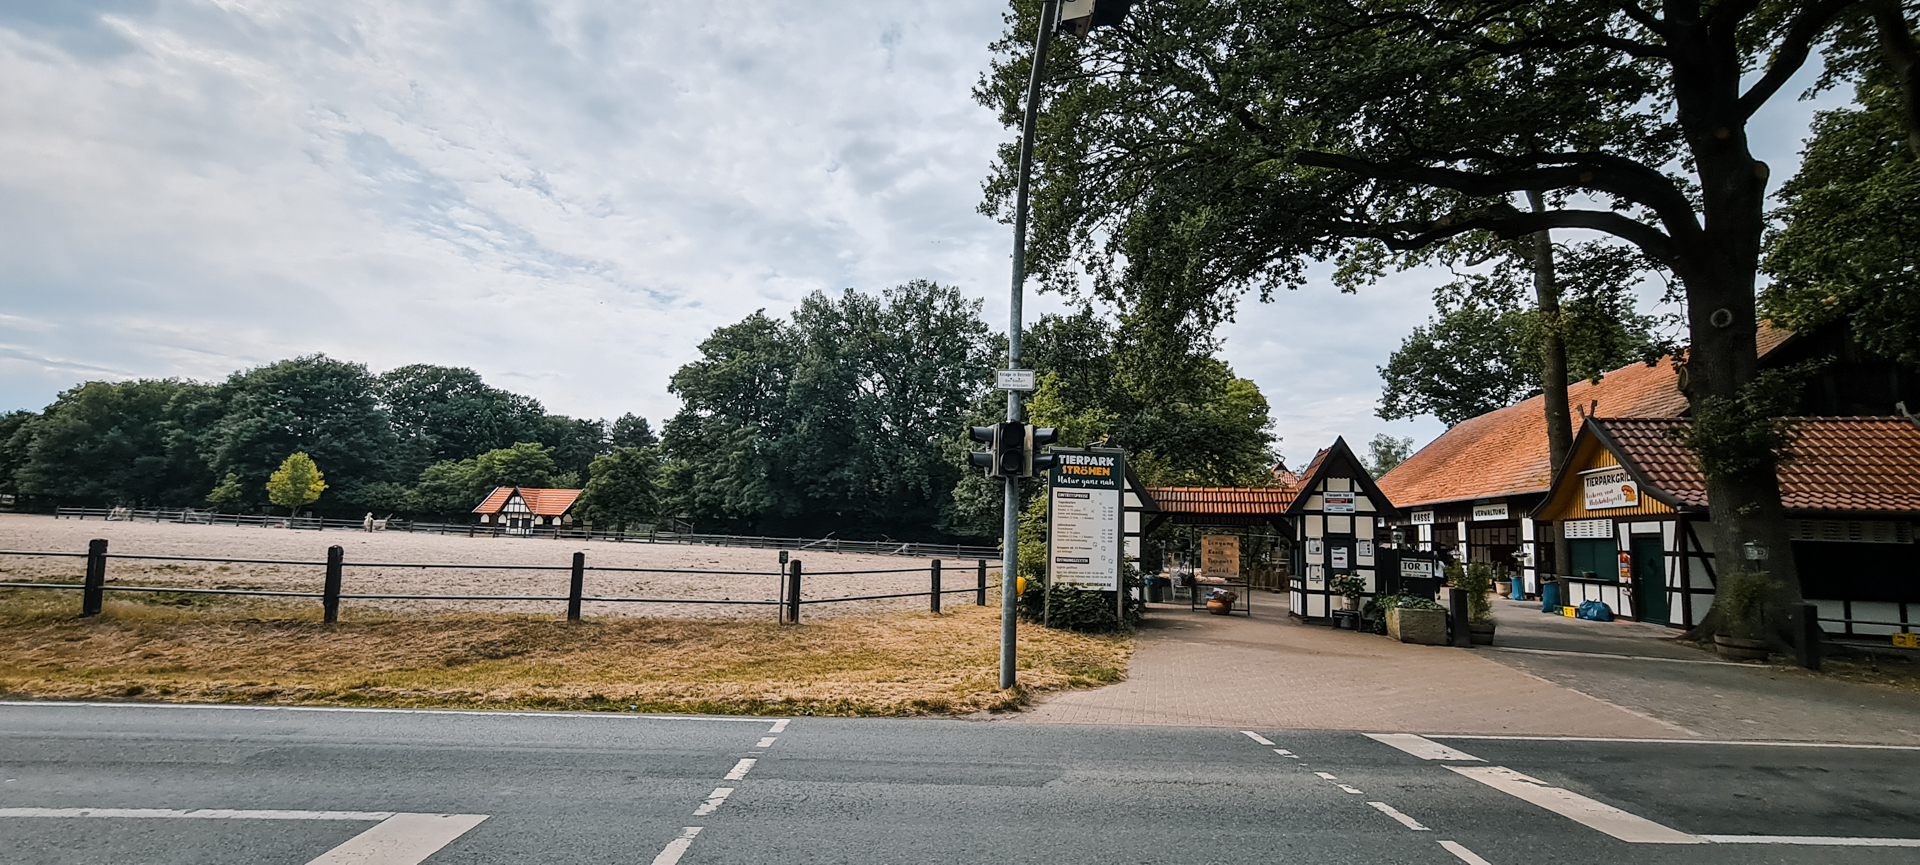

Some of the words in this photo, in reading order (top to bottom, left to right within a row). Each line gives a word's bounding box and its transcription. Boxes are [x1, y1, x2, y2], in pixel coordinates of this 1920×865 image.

[1058, 454, 1114, 466] TIERPARK
[1062, 465, 1110, 476] STRÖHEN
[1058, 475, 1080, 484] Natur
[1082, 479, 1098, 488] ganz
[1475, 508, 1506, 516] VERWALTUNG
[1414, 513, 1431, 522] KASSE
[1403, 562, 1420, 570] TOR
